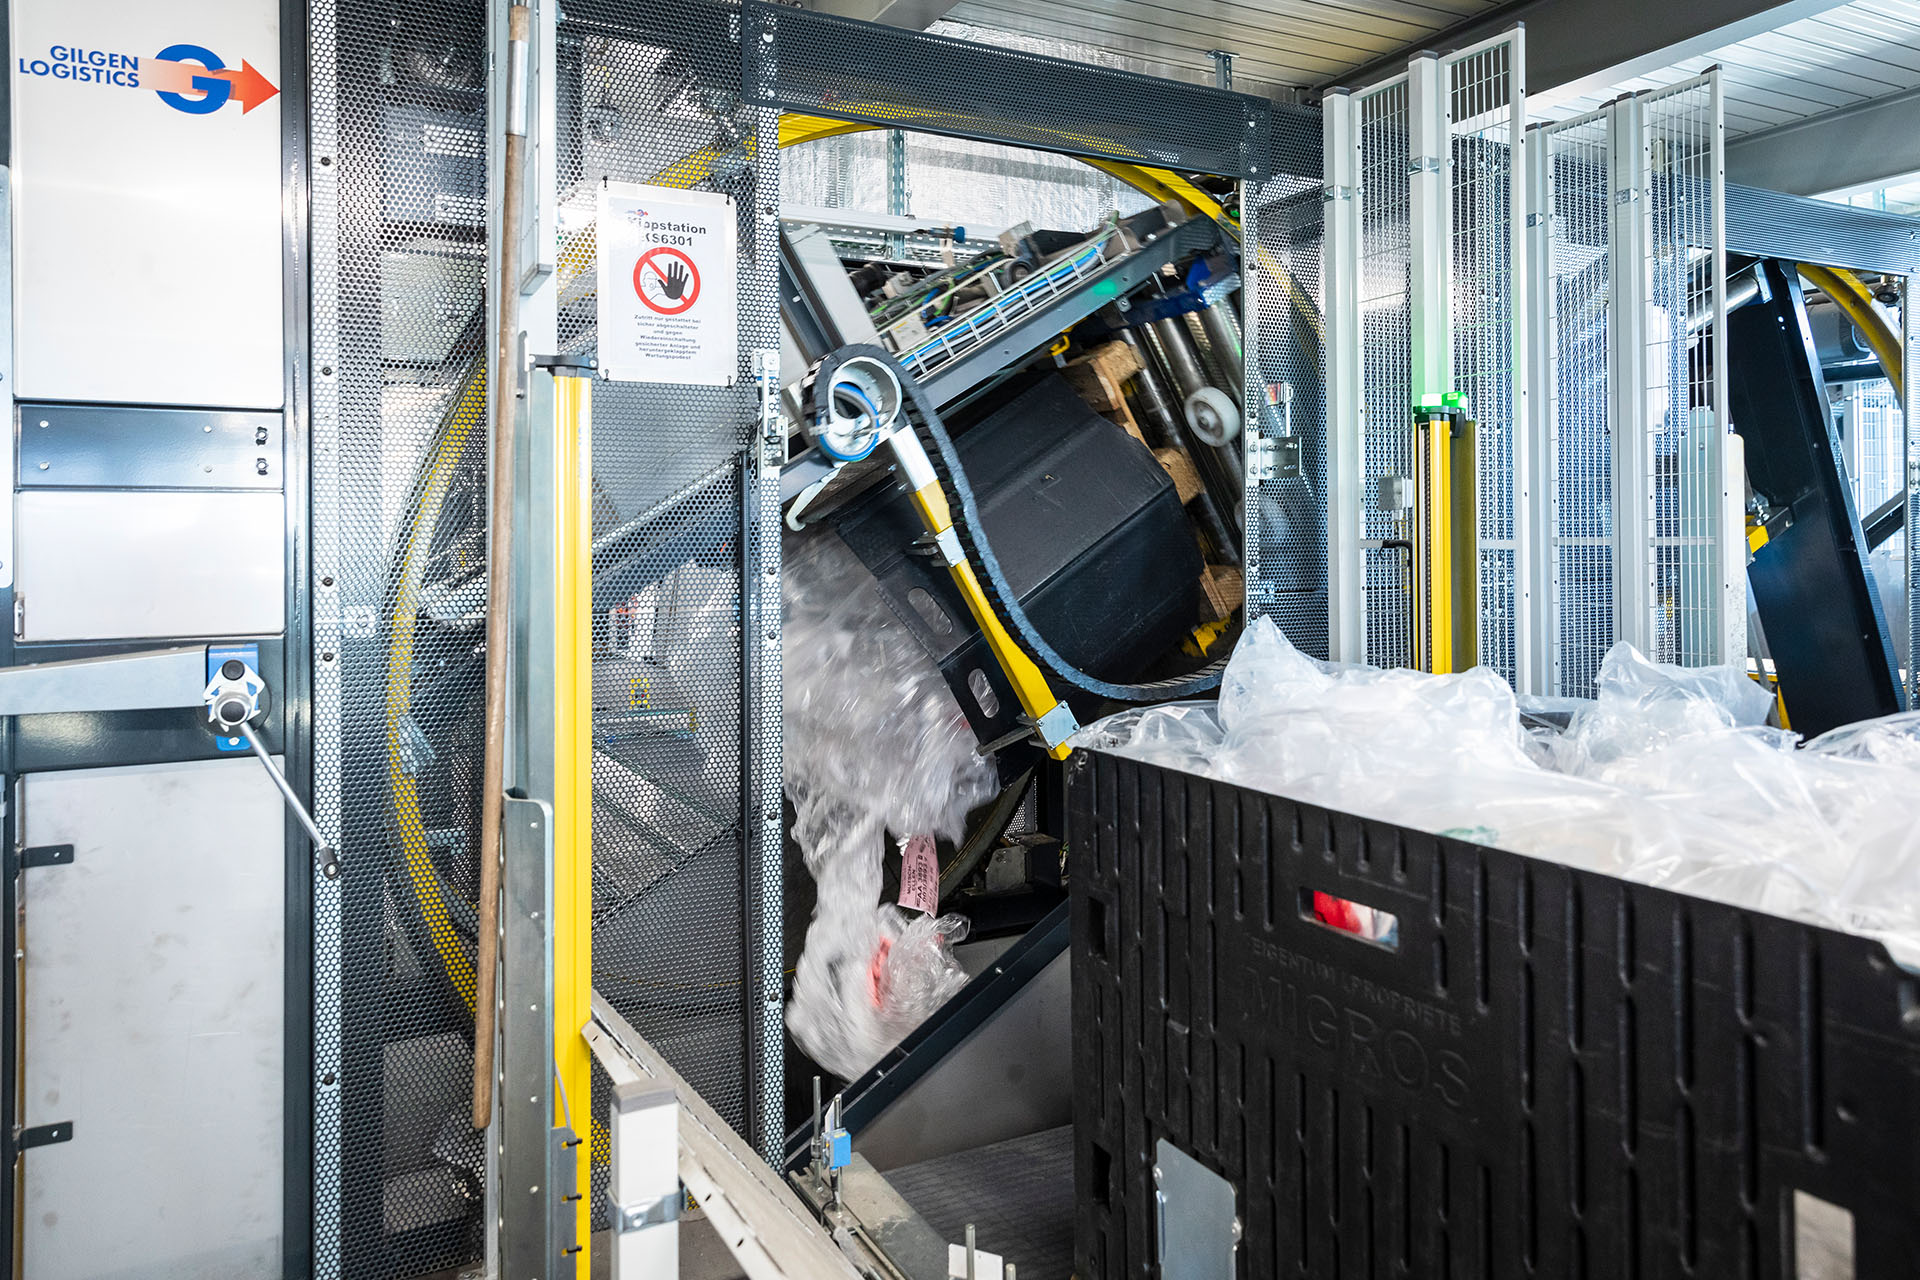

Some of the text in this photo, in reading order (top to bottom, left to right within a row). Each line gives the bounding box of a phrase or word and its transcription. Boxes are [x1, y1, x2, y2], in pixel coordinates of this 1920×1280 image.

[19, 58, 140, 88] LOGISTICS
[50, 45, 139, 71] GILGEN
[1243, 964, 1472, 1108] MIGROS
